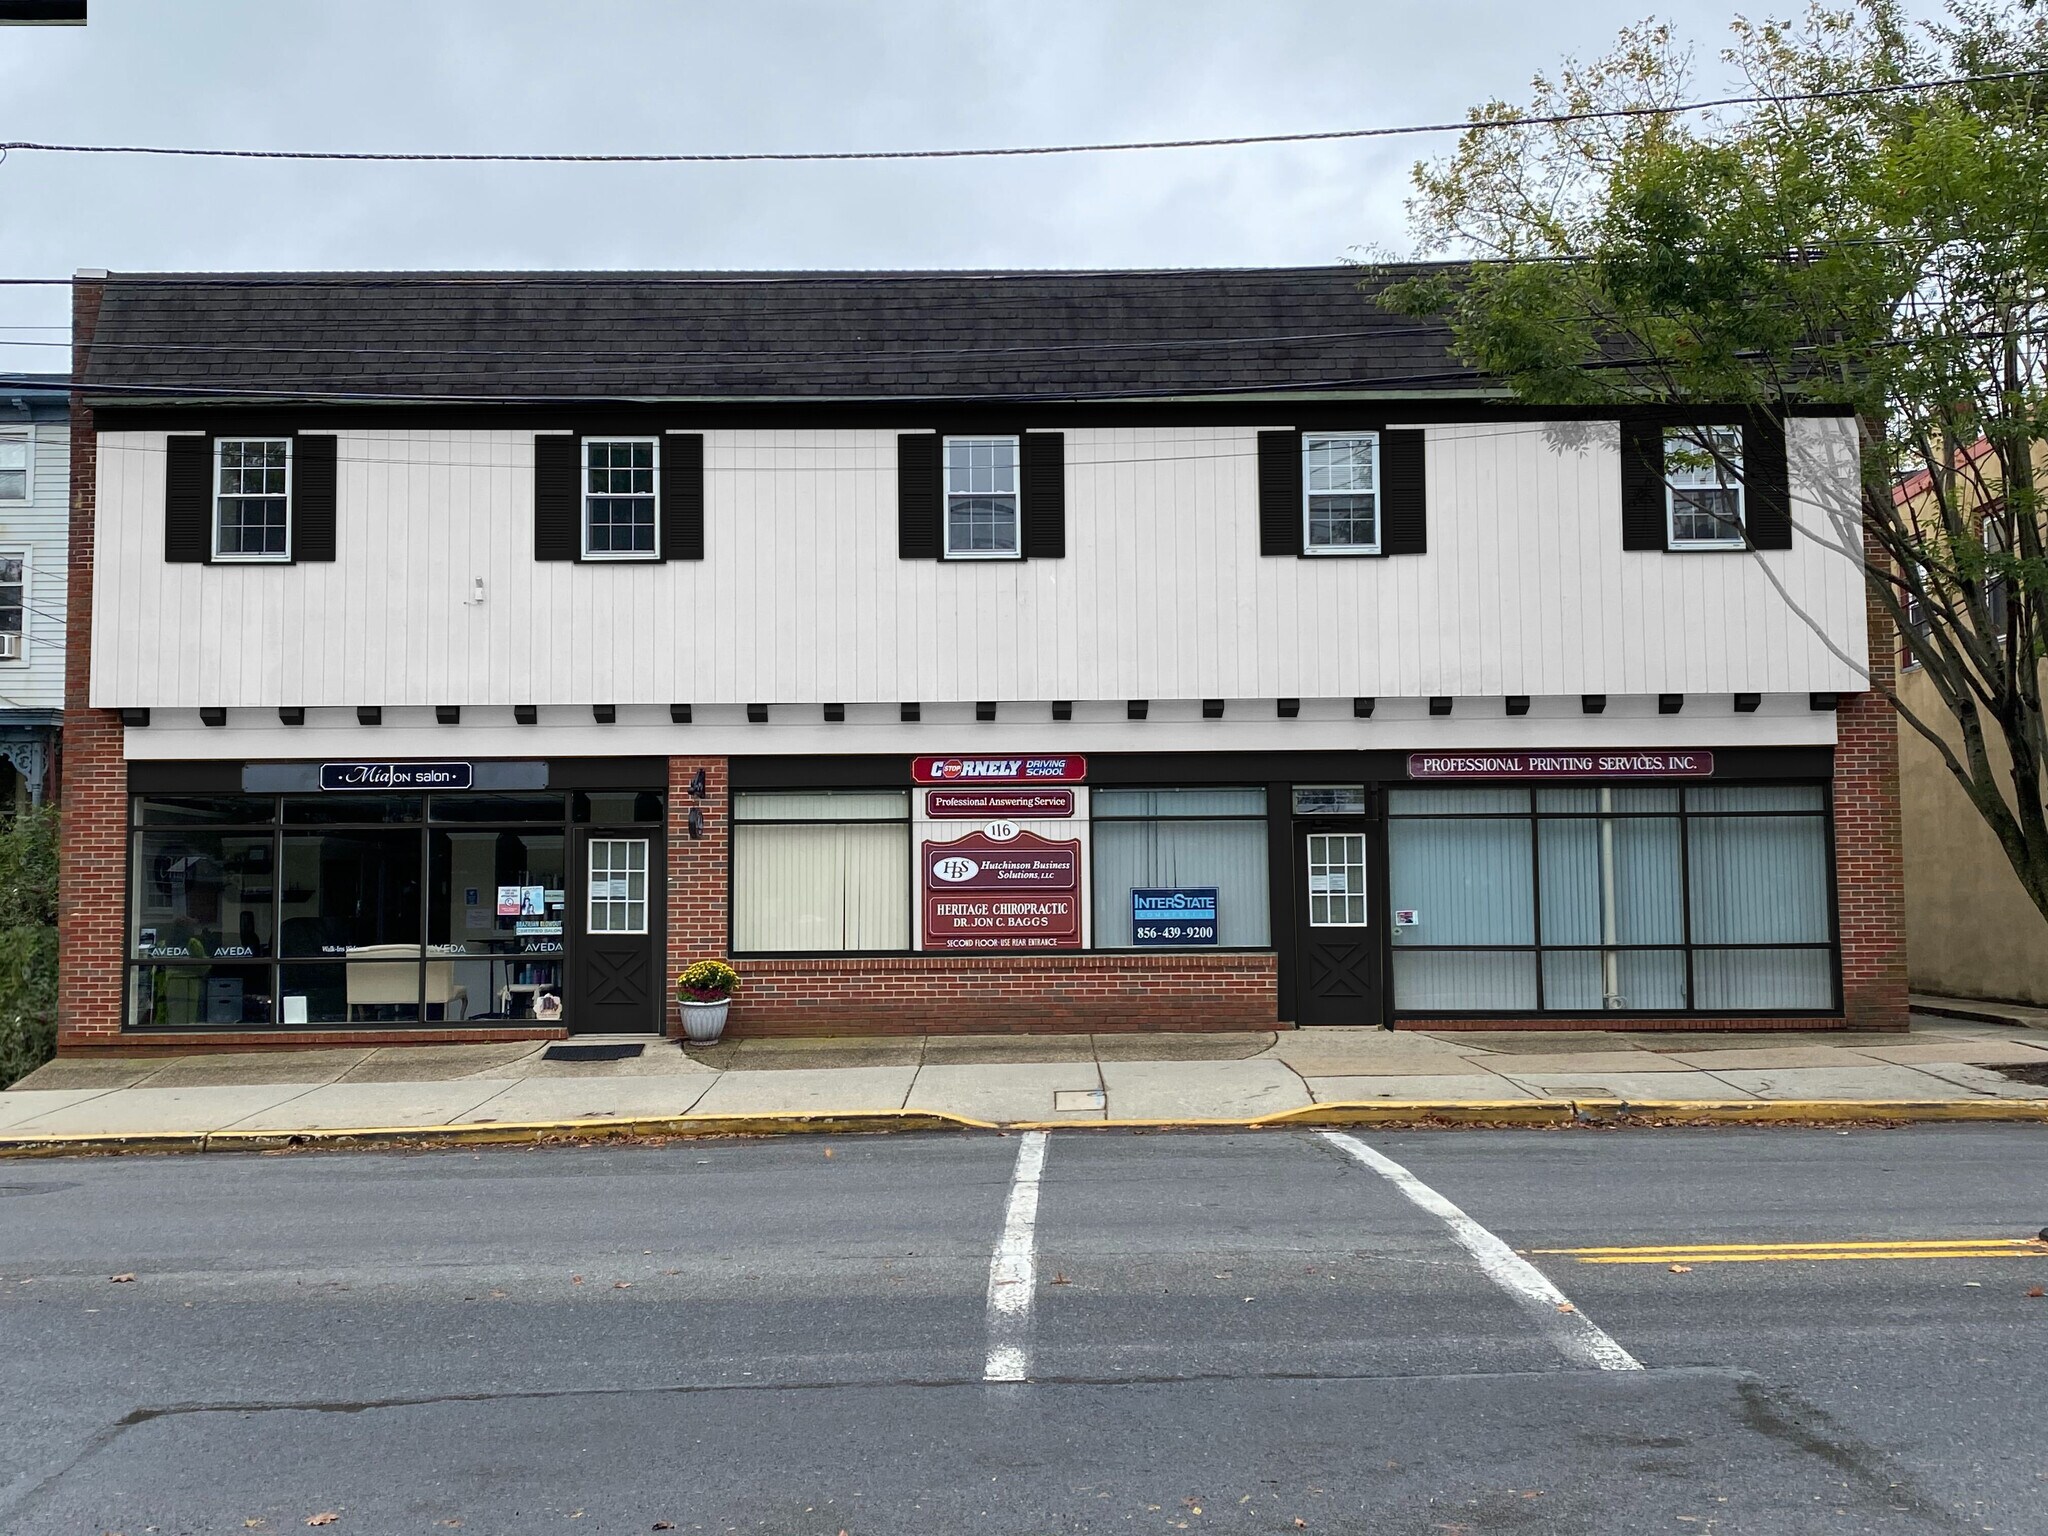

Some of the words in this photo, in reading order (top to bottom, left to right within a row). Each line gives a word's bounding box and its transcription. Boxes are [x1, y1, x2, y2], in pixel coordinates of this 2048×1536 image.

[1026, 759, 1066, 768] DRIVING
[1423, 758, 1523, 772] PROFESSIONAL
[1528, 757, 1593, 771] PRINTING
[1668, 756, 1697, 770] INC.
[415, 770, 450, 782] salon
[1026, 767, 1065, 776] SCHOOL
[935, 797, 988, 807] Professional
[989, 797, 1034, 808] Answering
[1034, 797, 1066, 806] Service
[992, 823, 1011, 837] 116
[980, 860, 1032, 870] Hutchinson
[1033, 860, 1071, 870] Business
[997, 870, 1040, 880] Solutions,
[937, 903, 989, 915] HERITAGE
[992, 902, 1068, 915] CHIROPRACTIC
[953, 917, 970, 927] DR.
[971, 917, 993, 927] JON
[995, 917, 1006, 927] C.
[1007, 916, 1048, 927] BAGGS
[1137, 926, 1213, 939] 856-439-9200
[525, 942, 564, 952] AVEDA
[946, 939, 973, 948] SECOND
[1012, 938, 1027, 947] REAR
[1028, 938, 1058, 947] ENTRANCE
[151, 947, 190, 956] AVEDA
[214, 946, 253, 956] AVEDA
